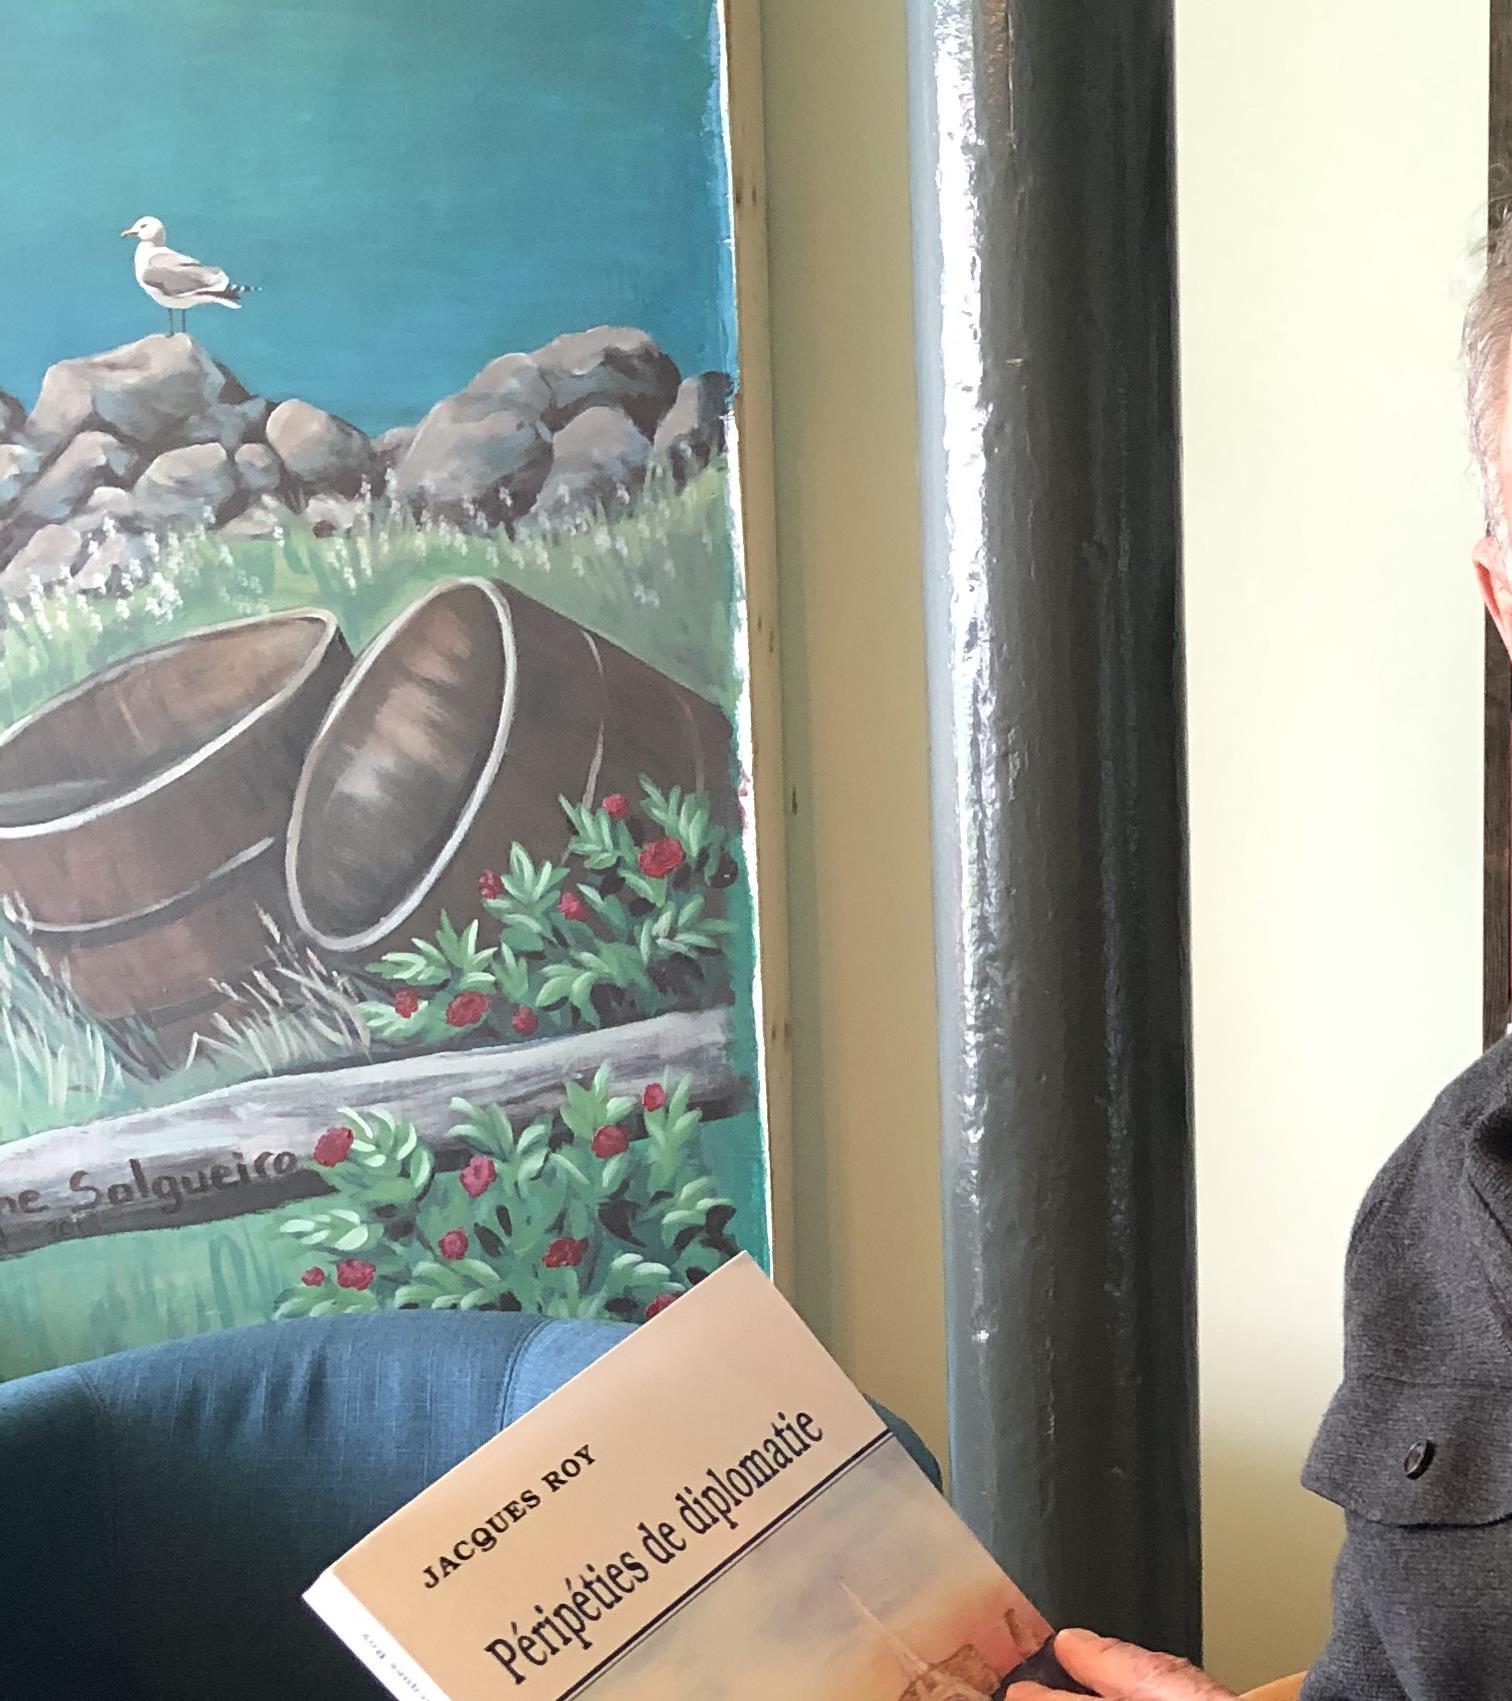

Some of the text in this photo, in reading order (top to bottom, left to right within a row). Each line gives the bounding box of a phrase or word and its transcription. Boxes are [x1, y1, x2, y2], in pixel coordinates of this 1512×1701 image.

[422, 1443, 598, 1590] JACQUES ROY
[484, 1410, 824, 1688] Péripéties de diplomatie
